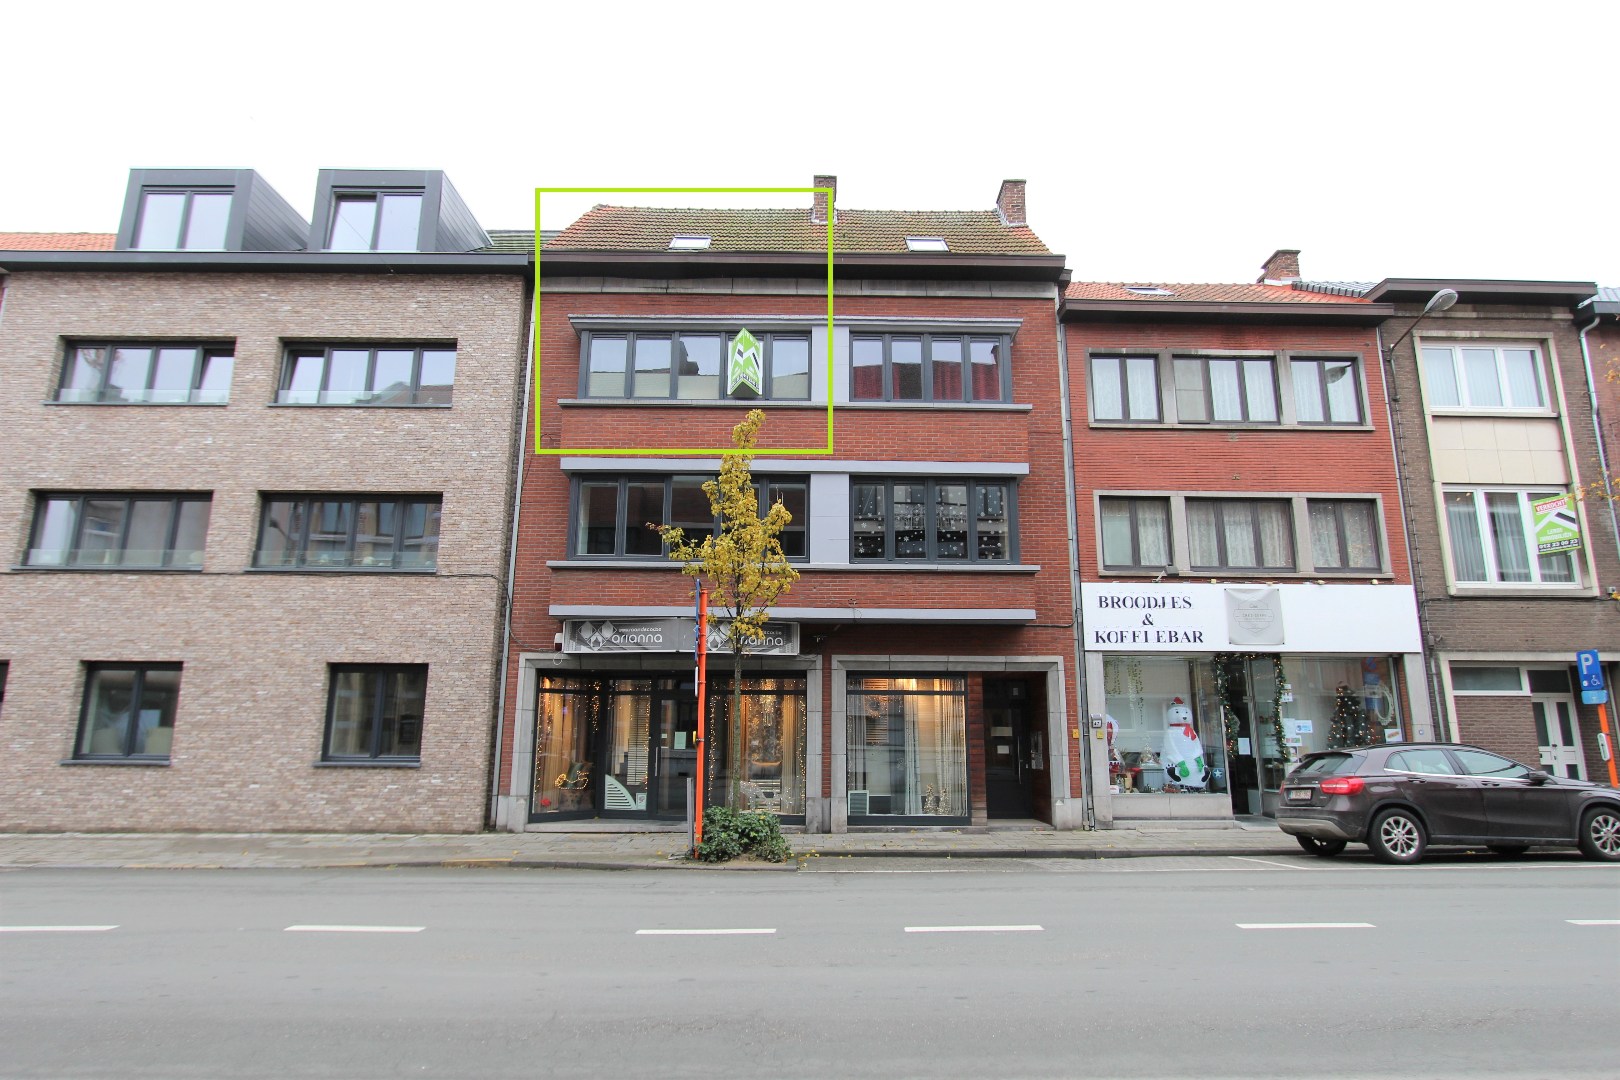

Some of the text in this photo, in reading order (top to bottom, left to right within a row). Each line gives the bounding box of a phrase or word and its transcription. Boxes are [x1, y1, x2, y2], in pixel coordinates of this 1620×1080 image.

[1098, 595, 1192, 609] BROODJES
[1142, 613, 1154, 626] &
[611, 633, 663, 643] arianna
[1095, 630, 1204, 644] KOFFIEBAR
[1580, 653, 1593, 675] P
